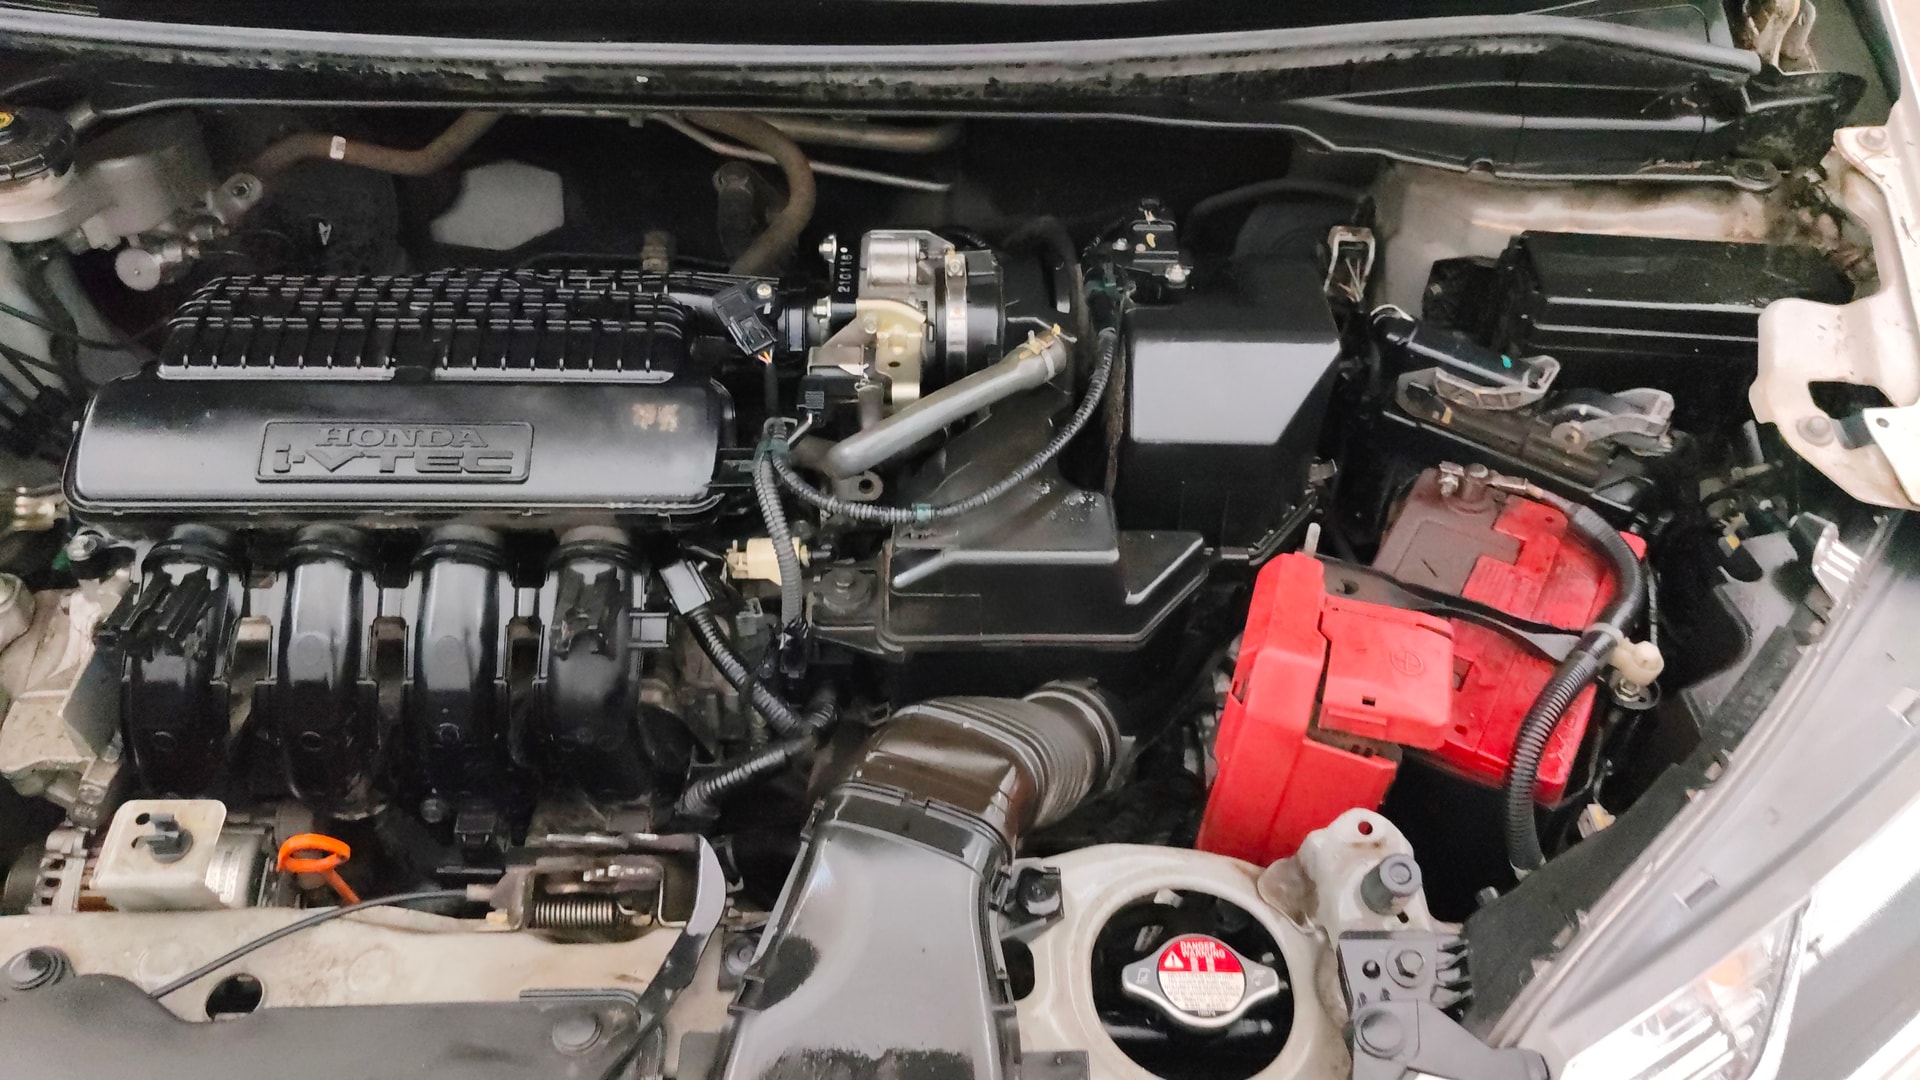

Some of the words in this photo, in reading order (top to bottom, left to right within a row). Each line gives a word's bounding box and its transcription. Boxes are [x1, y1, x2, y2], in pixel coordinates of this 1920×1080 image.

[315, 427, 489, 448] HONDA
[273, 444, 514, 474] i-VTEC
[1180, 941, 1216, 950] DANGER
